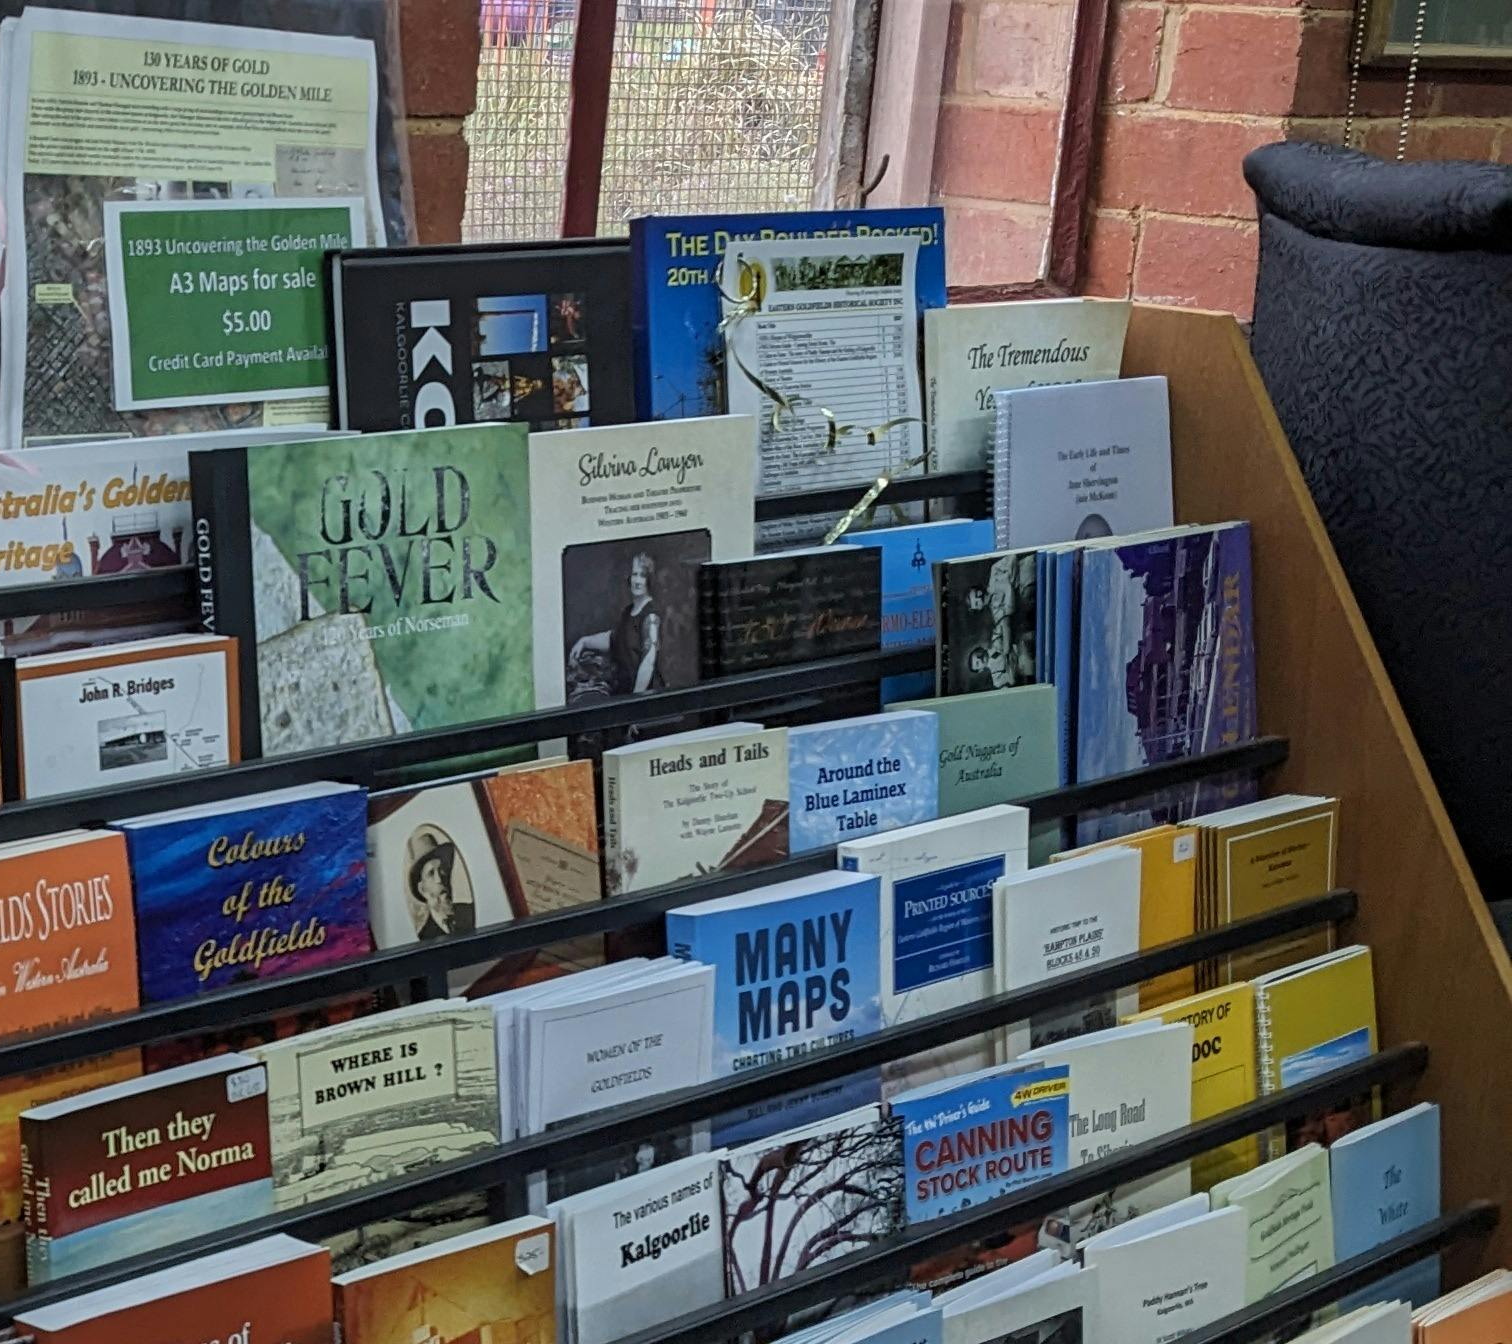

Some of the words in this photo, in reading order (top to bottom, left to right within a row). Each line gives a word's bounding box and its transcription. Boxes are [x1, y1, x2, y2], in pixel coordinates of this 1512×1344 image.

[143, 51, 162, 67] 130
[165, 53, 207, 72] YEARS
[211, 56, 230, 73] OF
[233, 58, 270, 75] GOLD
[73, 69, 98, 86] 1893
[110, 72, 205, 94] UNCOVERING
[209, 79, 238, 96] THE
[241, 82, 297, 101] GOLDEN
[300, 87, 332, 102] MILE
[169, 271, 194, 295] A3
[199, 270, 248, 297] Maps
[253, 268, 279, 291] for
[283, 267, 316, 289] sale
[869, 299, 891, 307] SOCIETY
[222, 309, 271, 335] $5.00
[967, 345, 994, 371] The
[997, 337, 1090, 368] Tremendous
[578, 452, 636, 486] Silvina
[639, 447, 704, 484] Lanyon
[319, 463, 473, 546] GOLD
[295, 533, 503, 623] FEVER
[649, 754, 693, 777] Heads
[699, 748, 726, 768] and
[733, 742, 769, 762] Tails
[816, 763, 876, 786] Around
[880, 757, 902, 777] the
[804, 789, 842, 813] Blue
[846, 780, 907, 810] Laminex
[836, 810, 879, 832] Table
[222, 892, 248, 923] of
[258, 880, 295, 905] the
[733, 908, 854, 988] MANY
[738, 965, 853, 1046] MAPS
[330, 1046, 395, 1075] WHERE
[399, 1041, 419, 1060] IS
[732, 1050, 784, 1073] CHARTING
[786, 1044, 810, 1061] TWO
[102, 1126, 162, 1159] Then
[168, 1108, 216, 1144] they
[916, 1110, 1054, 1174] CANNING
[67, 1174, 133, 1210] called
[137, 1164, 172, 1191] me
[177, 1139, 255, 1178] Norma
[916, 1164, 982, 1202] STOCK
[986, 1145, 1052, 1180] ROUTE
[613, 1211, 632, 1229] The
[634, 1195, 668, 1220] various
[671, 1181, 701, 1205] names
[704, 1171, 713, 1190] of
[620, 1212, 710, 1268] Kalgoorlie
